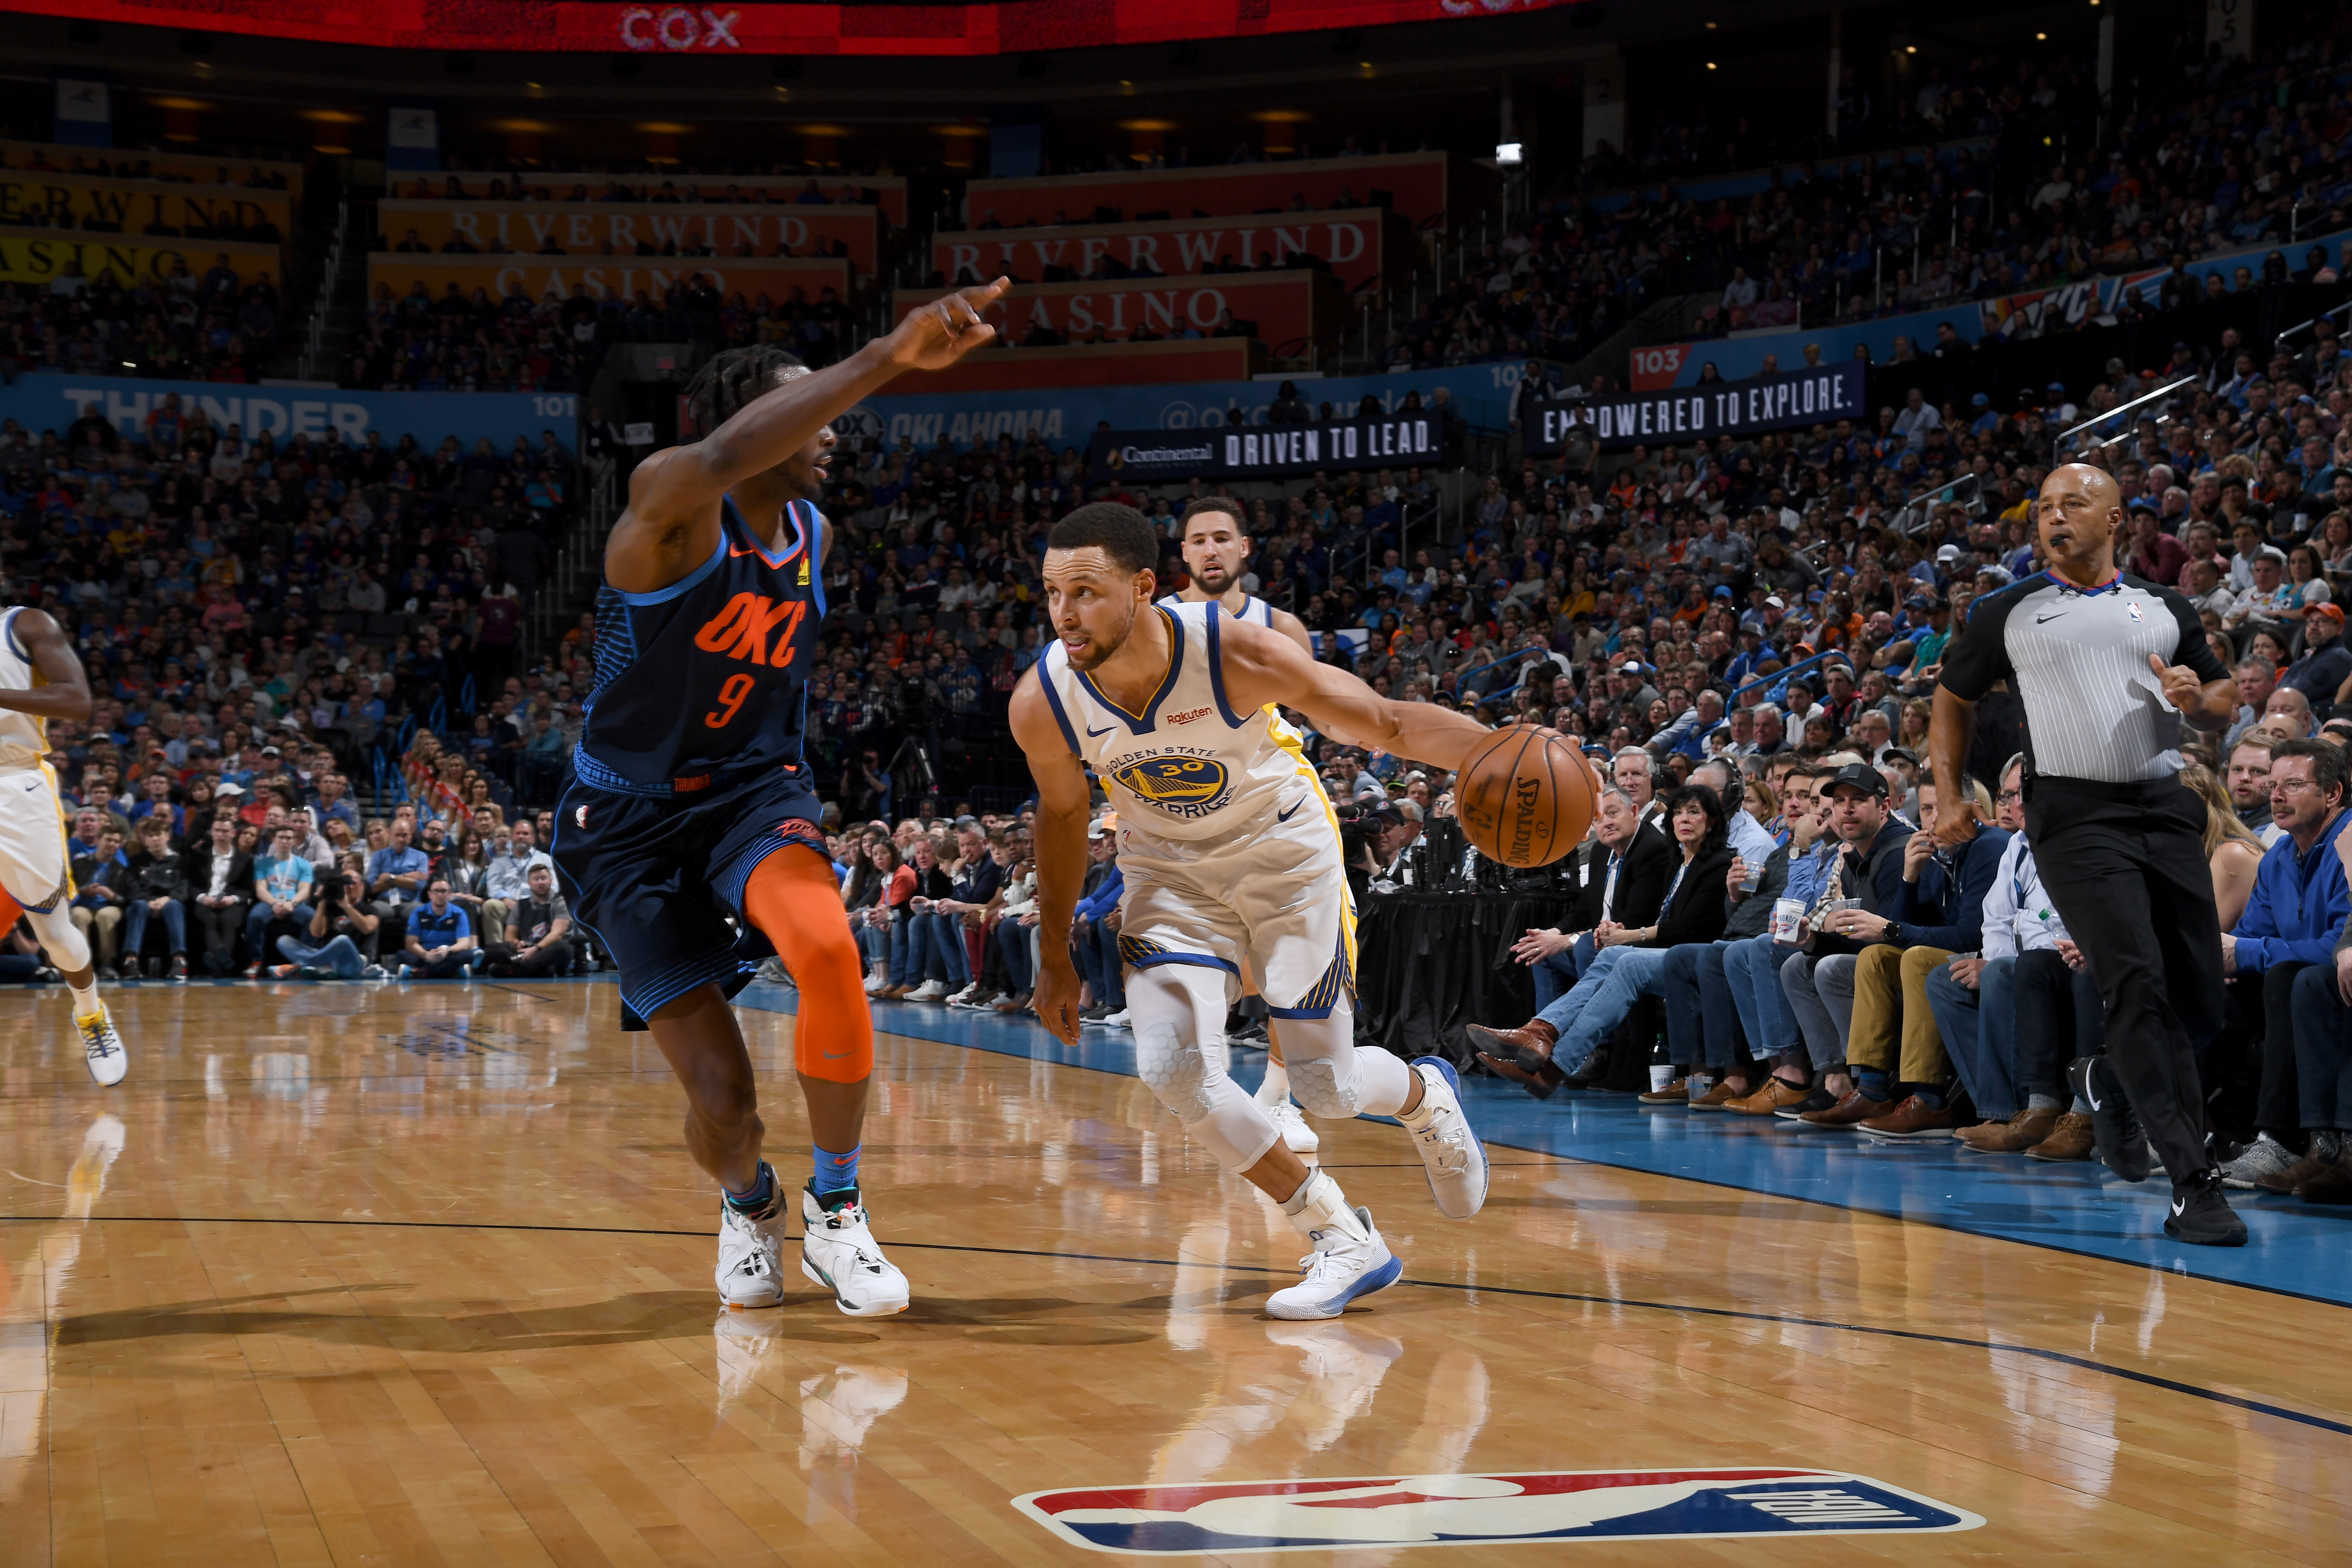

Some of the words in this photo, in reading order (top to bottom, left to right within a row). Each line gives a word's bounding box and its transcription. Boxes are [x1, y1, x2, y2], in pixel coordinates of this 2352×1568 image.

[618, 7, 742, 50] COX
[452, 212, 808, 248] RIVERWIND
[949, 222, 1366, 282] RIVERWIND
[980, 289, 1227, 336] CASINO
[1491, 365, 1526, 388] 10
[1634, 348, 1680, 375] 103
[533, 396, 575, 417] 101
[1715, 391, 1739, 427] TO
[1749, 374, 1853, 423] EXPLORE.
[890, 408, 1062, 444] OKLAHOMA
[1225, 429, 1320, 466] DRIVEN
[1329, 425, 1358, 460] TO
[1368, 419, 1439, 457] LEAD.
[1121, 442, 1213, 463] Continental
[695, 592, 806, 668] OKC
[705, 673, 754, 729] 9
[1167, 706, 1212, 725] Rakuten
[1105, 749, 1158, 773] GOLDEN
[1164, 746, 1217, 757] STATE
[1157, 762, 1204, 777] 30
[1505, 776, 1540, 864] SPALDING
[1778, 914, 1798, 926] THUNDER
[1724, 1489, 1922, 1524] NBA
